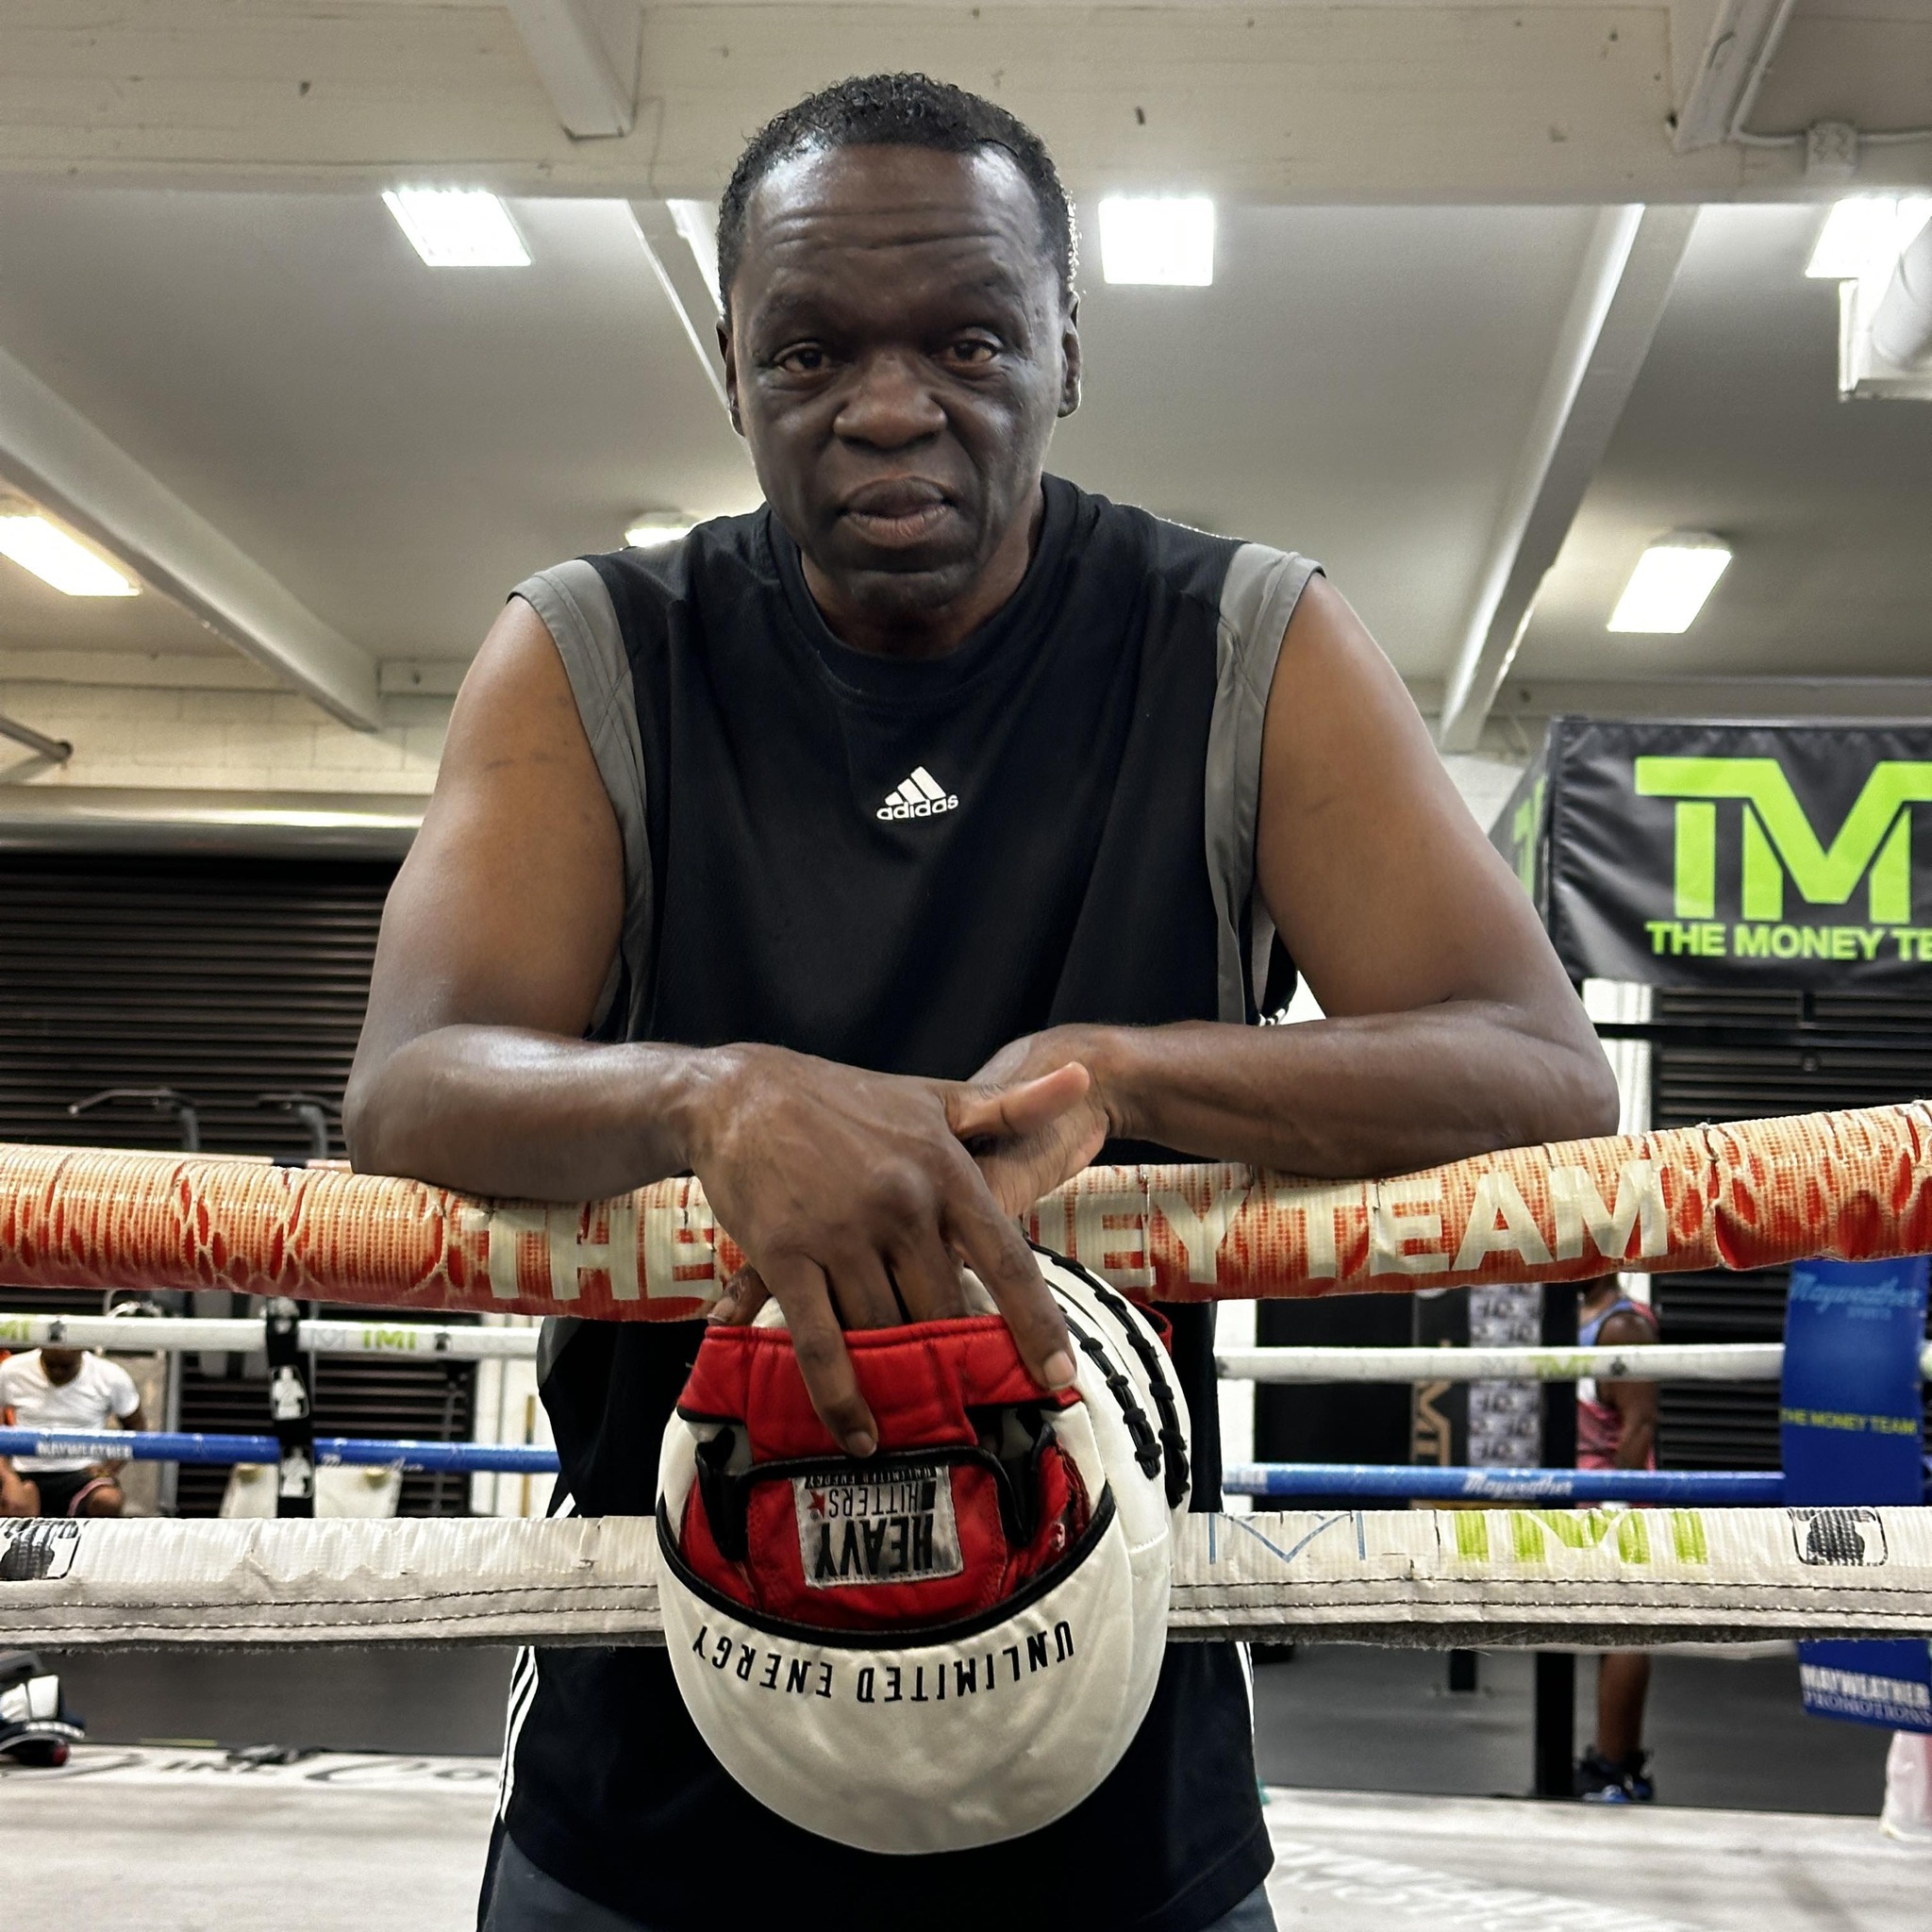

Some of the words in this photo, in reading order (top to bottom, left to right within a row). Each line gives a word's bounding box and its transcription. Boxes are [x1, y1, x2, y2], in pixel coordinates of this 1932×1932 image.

[876, 794, 958, 820] adidas
[1645, 922, 1726, 957] THE
[1734, 924, 1885, 961] MONEY
[1890, 927, 1932, 962] TE
[460, 1206, 724, 1300] THE
[1275, 1158, 1670, 1279] TEAM
[1780, 1408, 1807, 1426] THE
[1810, 1410, 1866, 1432] MONEY
[1870, 1416, 1918, 1435] TEAM
[828, 1481, 919, 1519] HITTERS
[814, 1512, 934, 1579] HEAVY
[691, 1624, 833, 1698] ENERGY
[856, 1620, 1074, 1703] UNLIMITED
